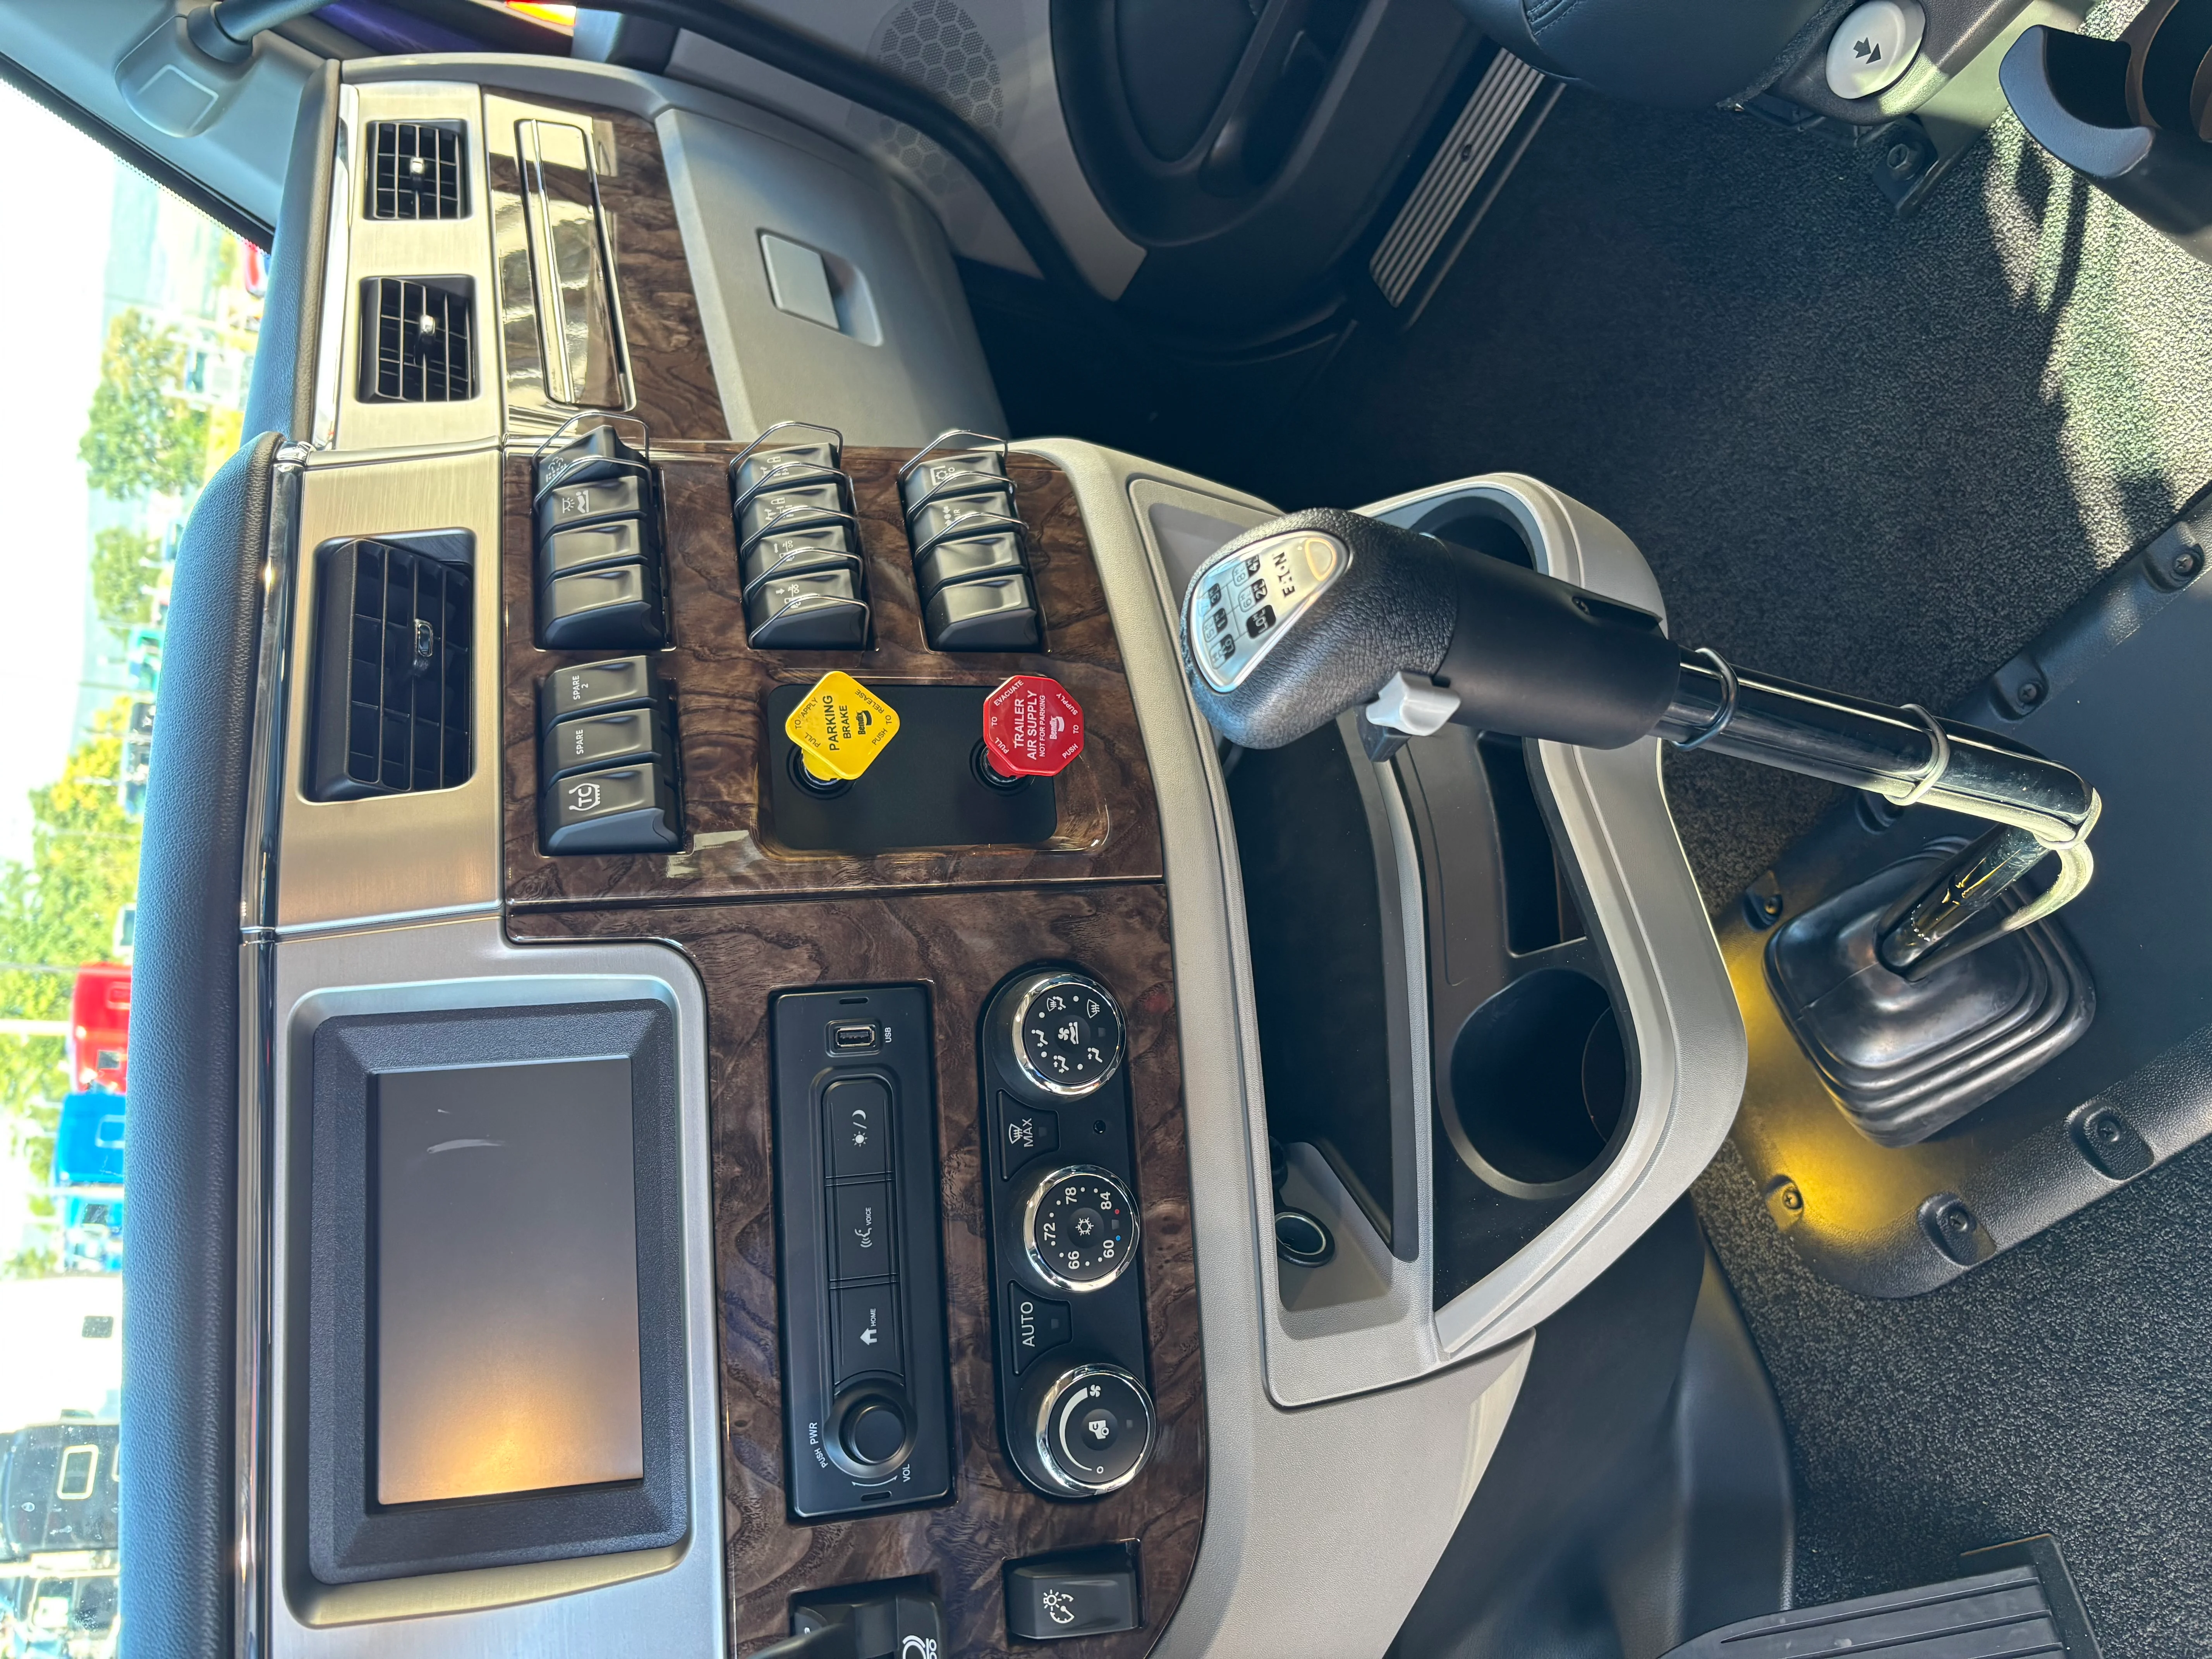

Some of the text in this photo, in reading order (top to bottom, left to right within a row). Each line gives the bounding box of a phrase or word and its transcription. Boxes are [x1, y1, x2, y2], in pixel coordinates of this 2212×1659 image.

[795, 697, 821, 747] PULL TO APPLY
[823, 695, 840, 750] PARKING
[839, 705, 851, 739] BRAKE
[855, 689, 892, 745] PUSH TO RELEASE
[856, 710, 866, 735] Bendix
[991, 680, 1024, 754] PULL TO EVACUATE
[1014, 698, 1024, 748] TRAILER
[1027, 690, 1037, 760] AIR SUPPLY
[1056, 693, 1079, 759] PUSH TO SUPPLY
[576, 729, 584, 755] SPARE
[578, 787, 592, 807] TC
[1022, 1118, 1034, 1147] MAX
[1065, 1187, 1077, 1205] 78
[1100, 1191, 1112, 1210] 84
[1043, 1222, 1056, 1241] 72
[1068, 1250, 1080, 1269] 66
[1103, 1240, 1115, 1258] 60
[1020, 1302, 1035, 1347] AUTO
[809, 1422, 828, 1468] PUSH PWR
[902, 1463, 911, 1483] VOL
